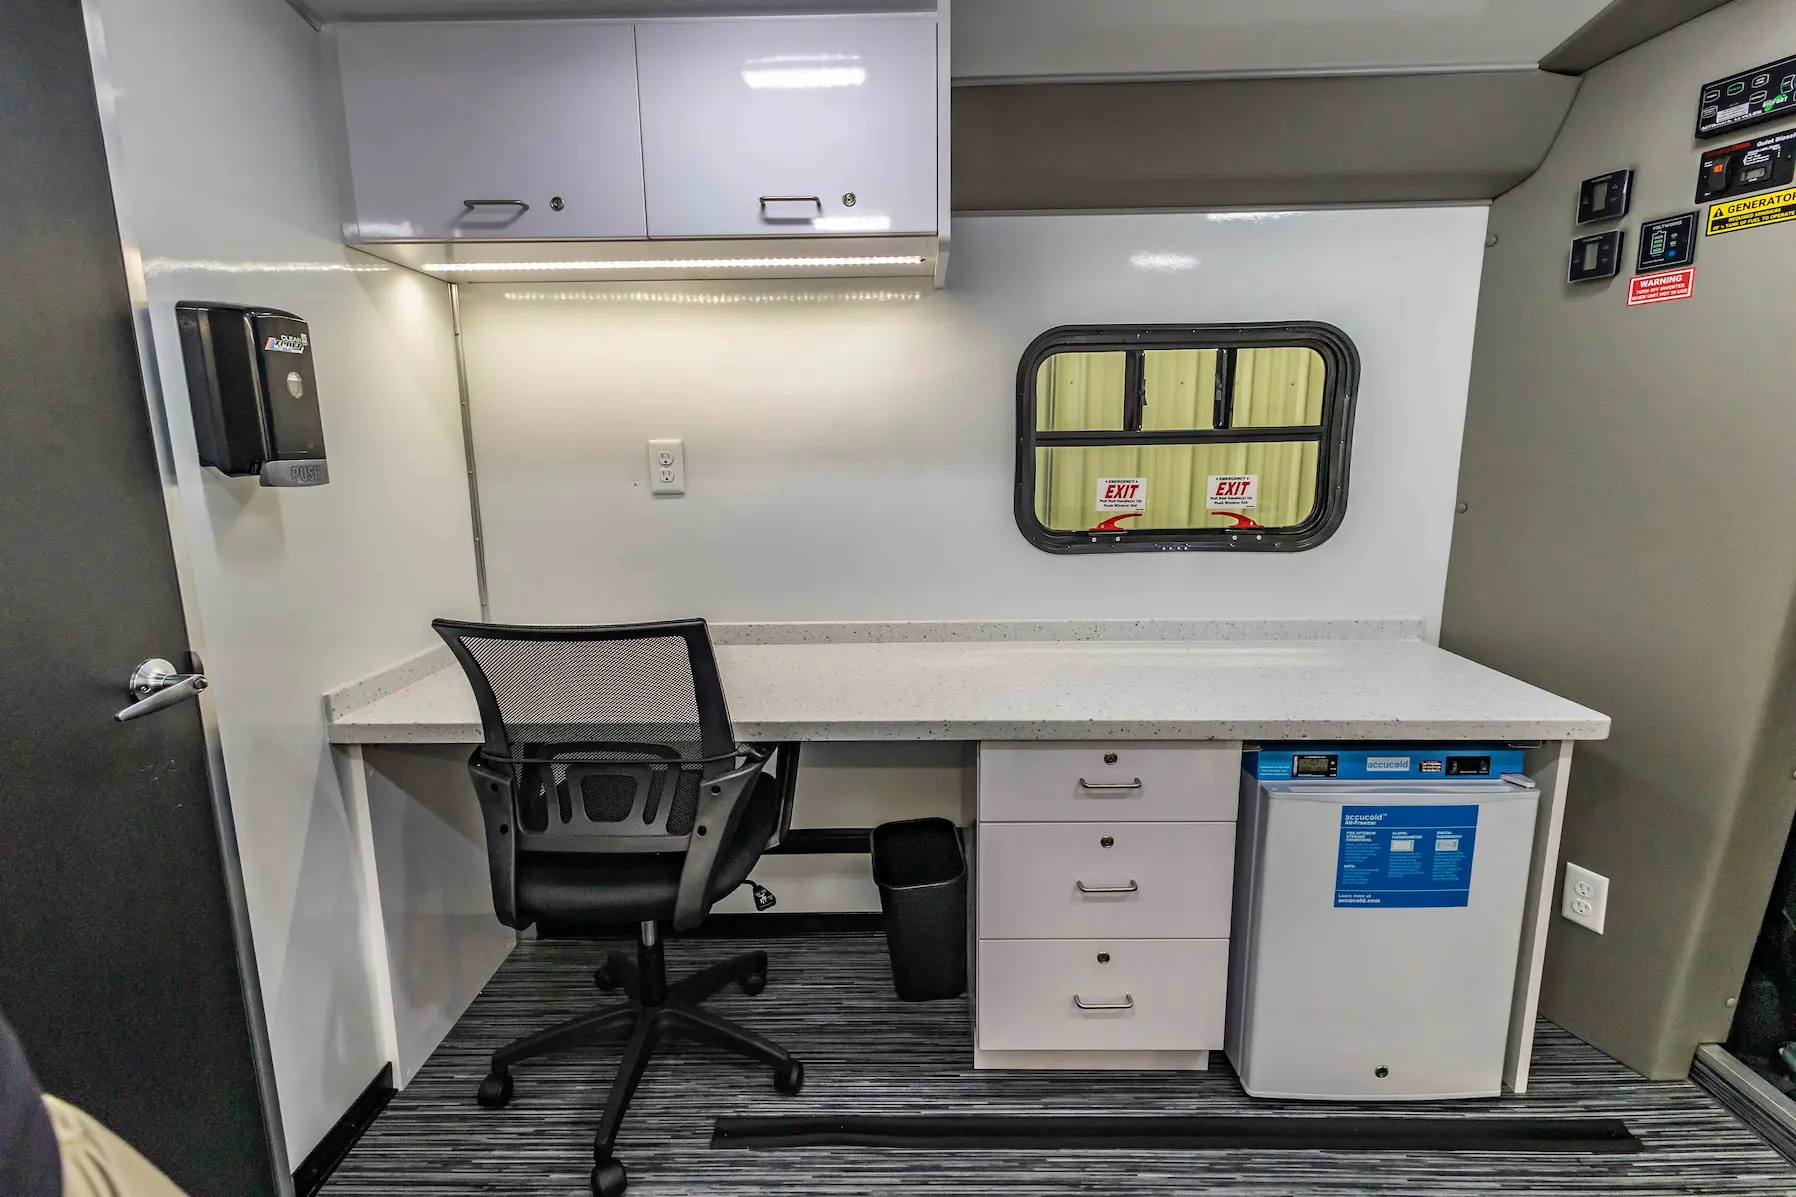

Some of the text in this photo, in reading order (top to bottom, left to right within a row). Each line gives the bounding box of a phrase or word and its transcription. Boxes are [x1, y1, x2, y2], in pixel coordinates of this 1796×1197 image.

[1757, 138, 1774, 148] Quiet
[1728, 208, 1781, 222] REQUIRED MINIMUM
[1770, 210, 1796, 219] OPERATE
[1652, 220, 1682, 230] VOLTWORKS
[1640, 274, 1682, 288] WARNING
[1660, 282, 1686, 291] INVERTER
[291, 465, 323, 482] PUSH
[1105, 484, 1139, 498] EXIT
[1216, 482, 1250, 496] EXIT
[1367, 760, 1408, 769] accucold
